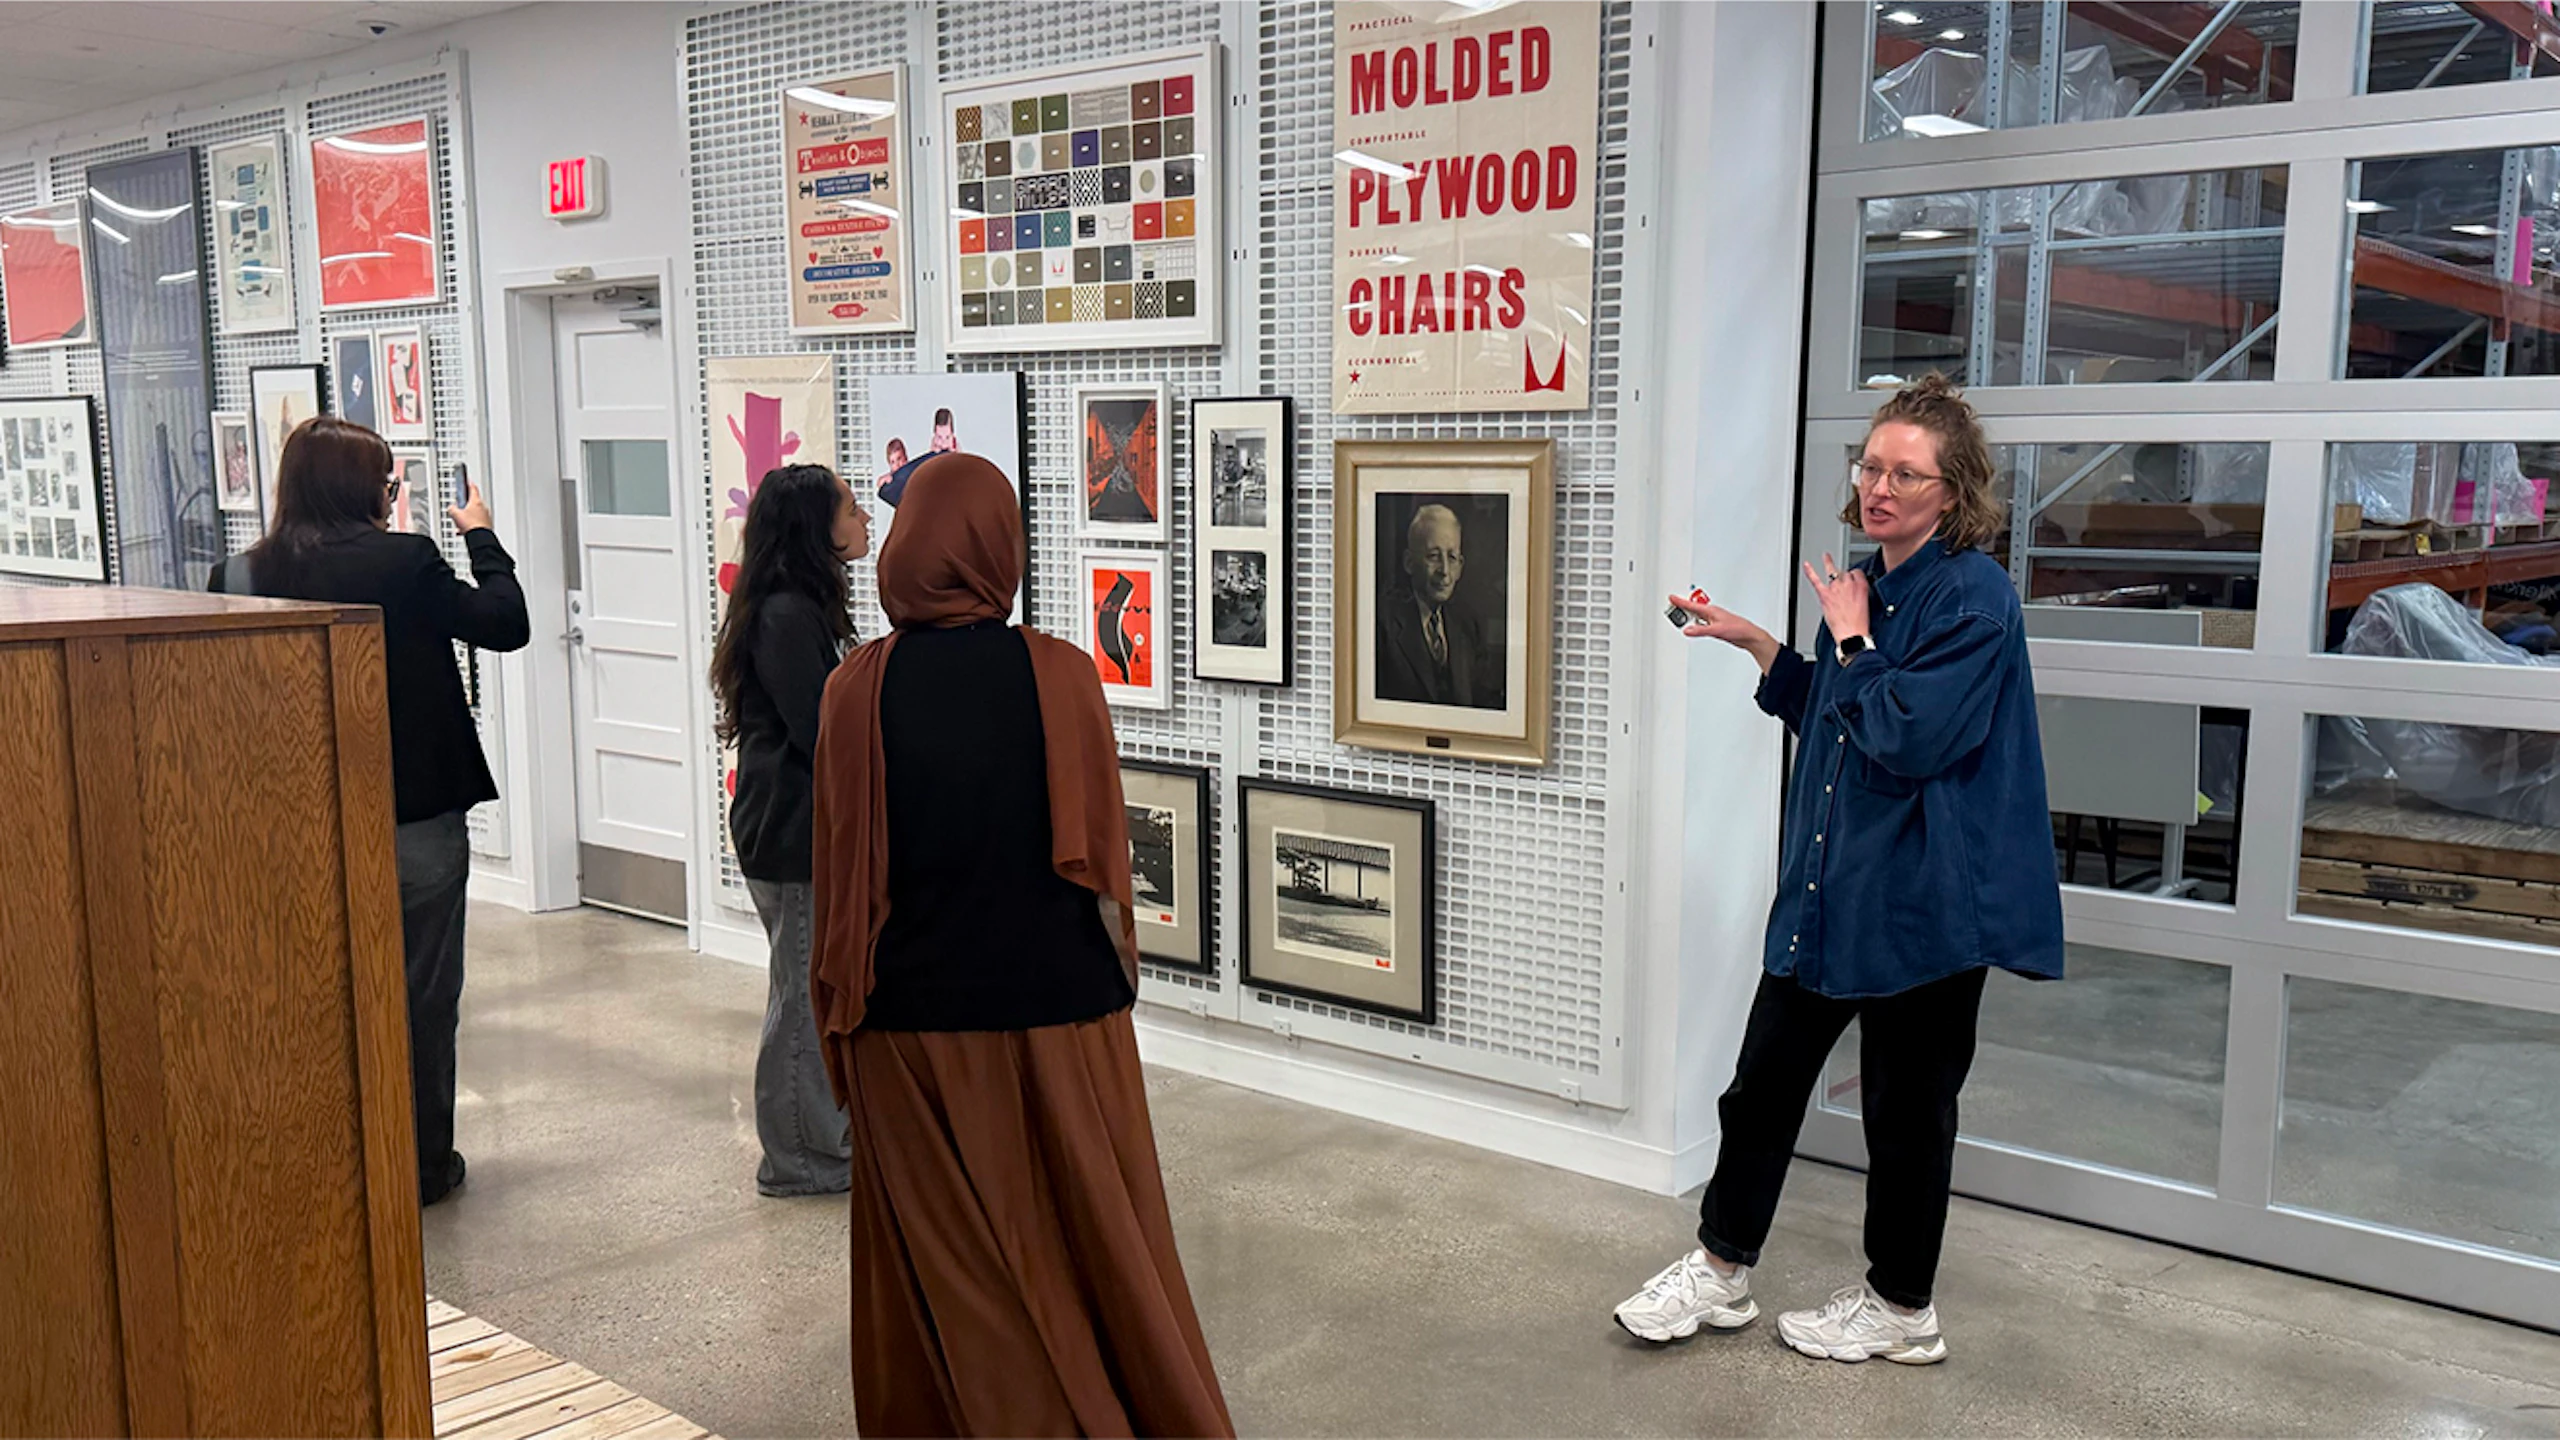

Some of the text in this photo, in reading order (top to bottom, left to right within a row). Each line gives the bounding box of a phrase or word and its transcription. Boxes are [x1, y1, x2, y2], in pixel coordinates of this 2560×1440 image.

[1349, 15, 1413, 32] PRACTICAL
[1350, 26, 1550, 115] MOLDED
[1349, 129, 1426, 148] COMFORTABLE
[549, 157, 586, 214] EXIT
[1349, 144, 1577, 228] PLYWOOD
[1349, 245, 1397, 258] DURABLE
[1349, 267, 1525, 336] CHAIRS
[1348, 356, 1417, 366] ECONOMICAL
